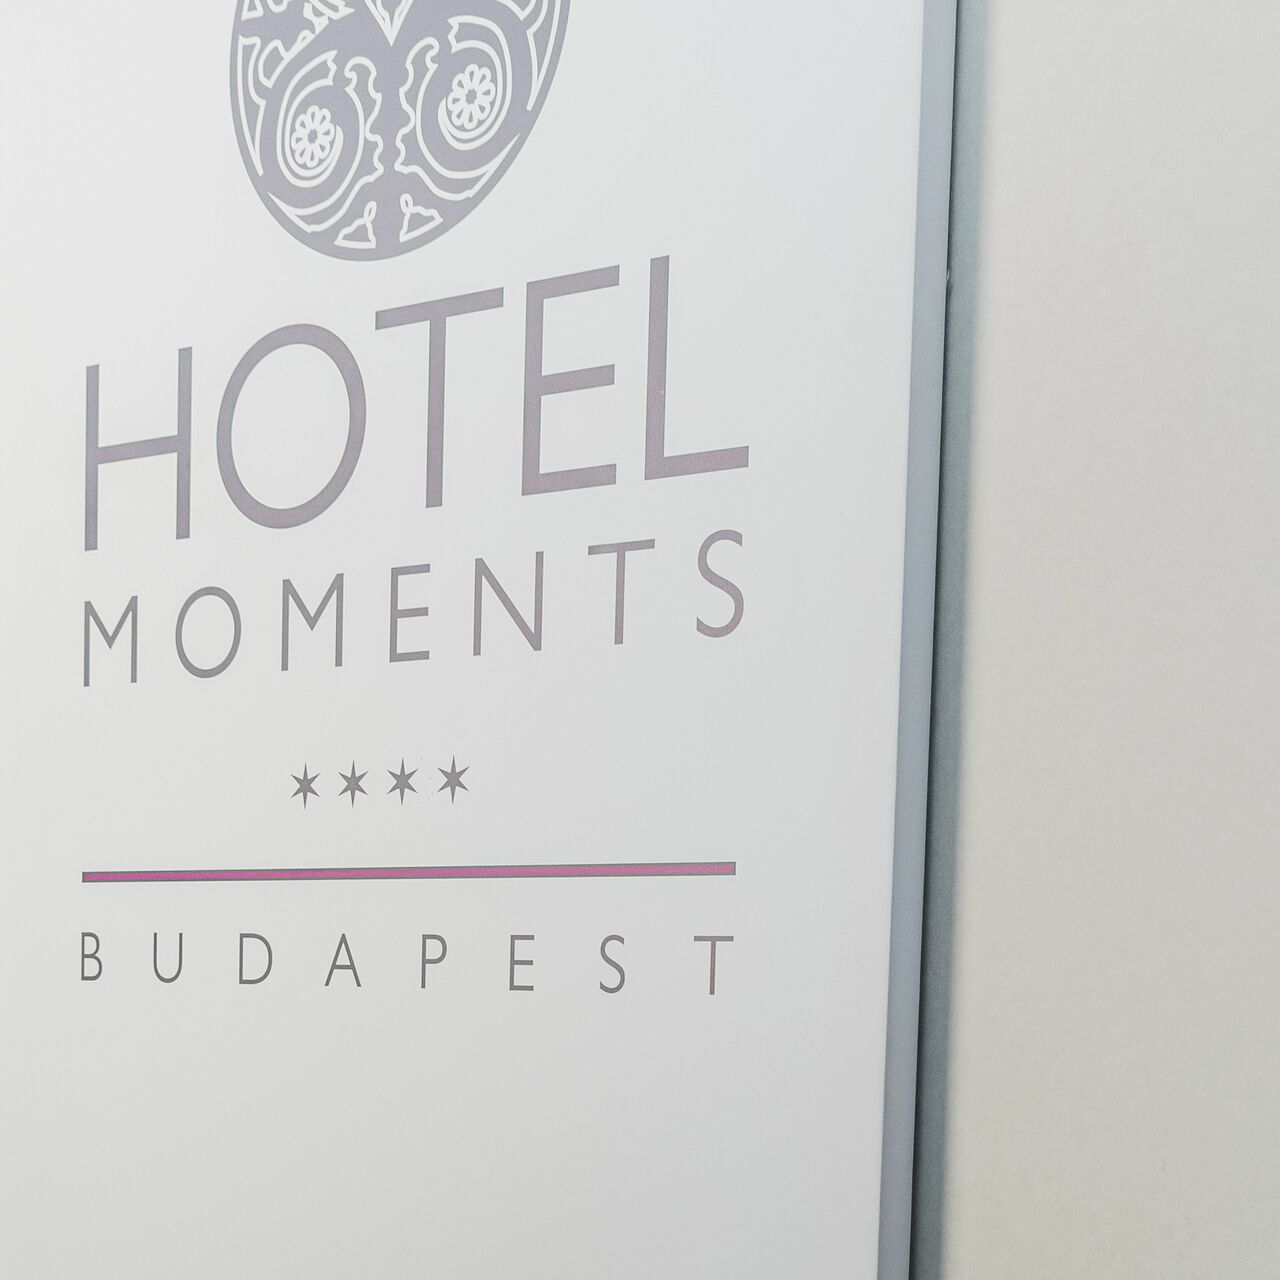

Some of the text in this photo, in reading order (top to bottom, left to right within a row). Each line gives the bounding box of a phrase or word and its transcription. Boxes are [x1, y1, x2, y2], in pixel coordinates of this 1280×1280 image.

[84, 254, 750, 552] HOTEL
[83, 528, 745, 688] MOMENTS
[80, 931, 735, 996] BUDAPEST
